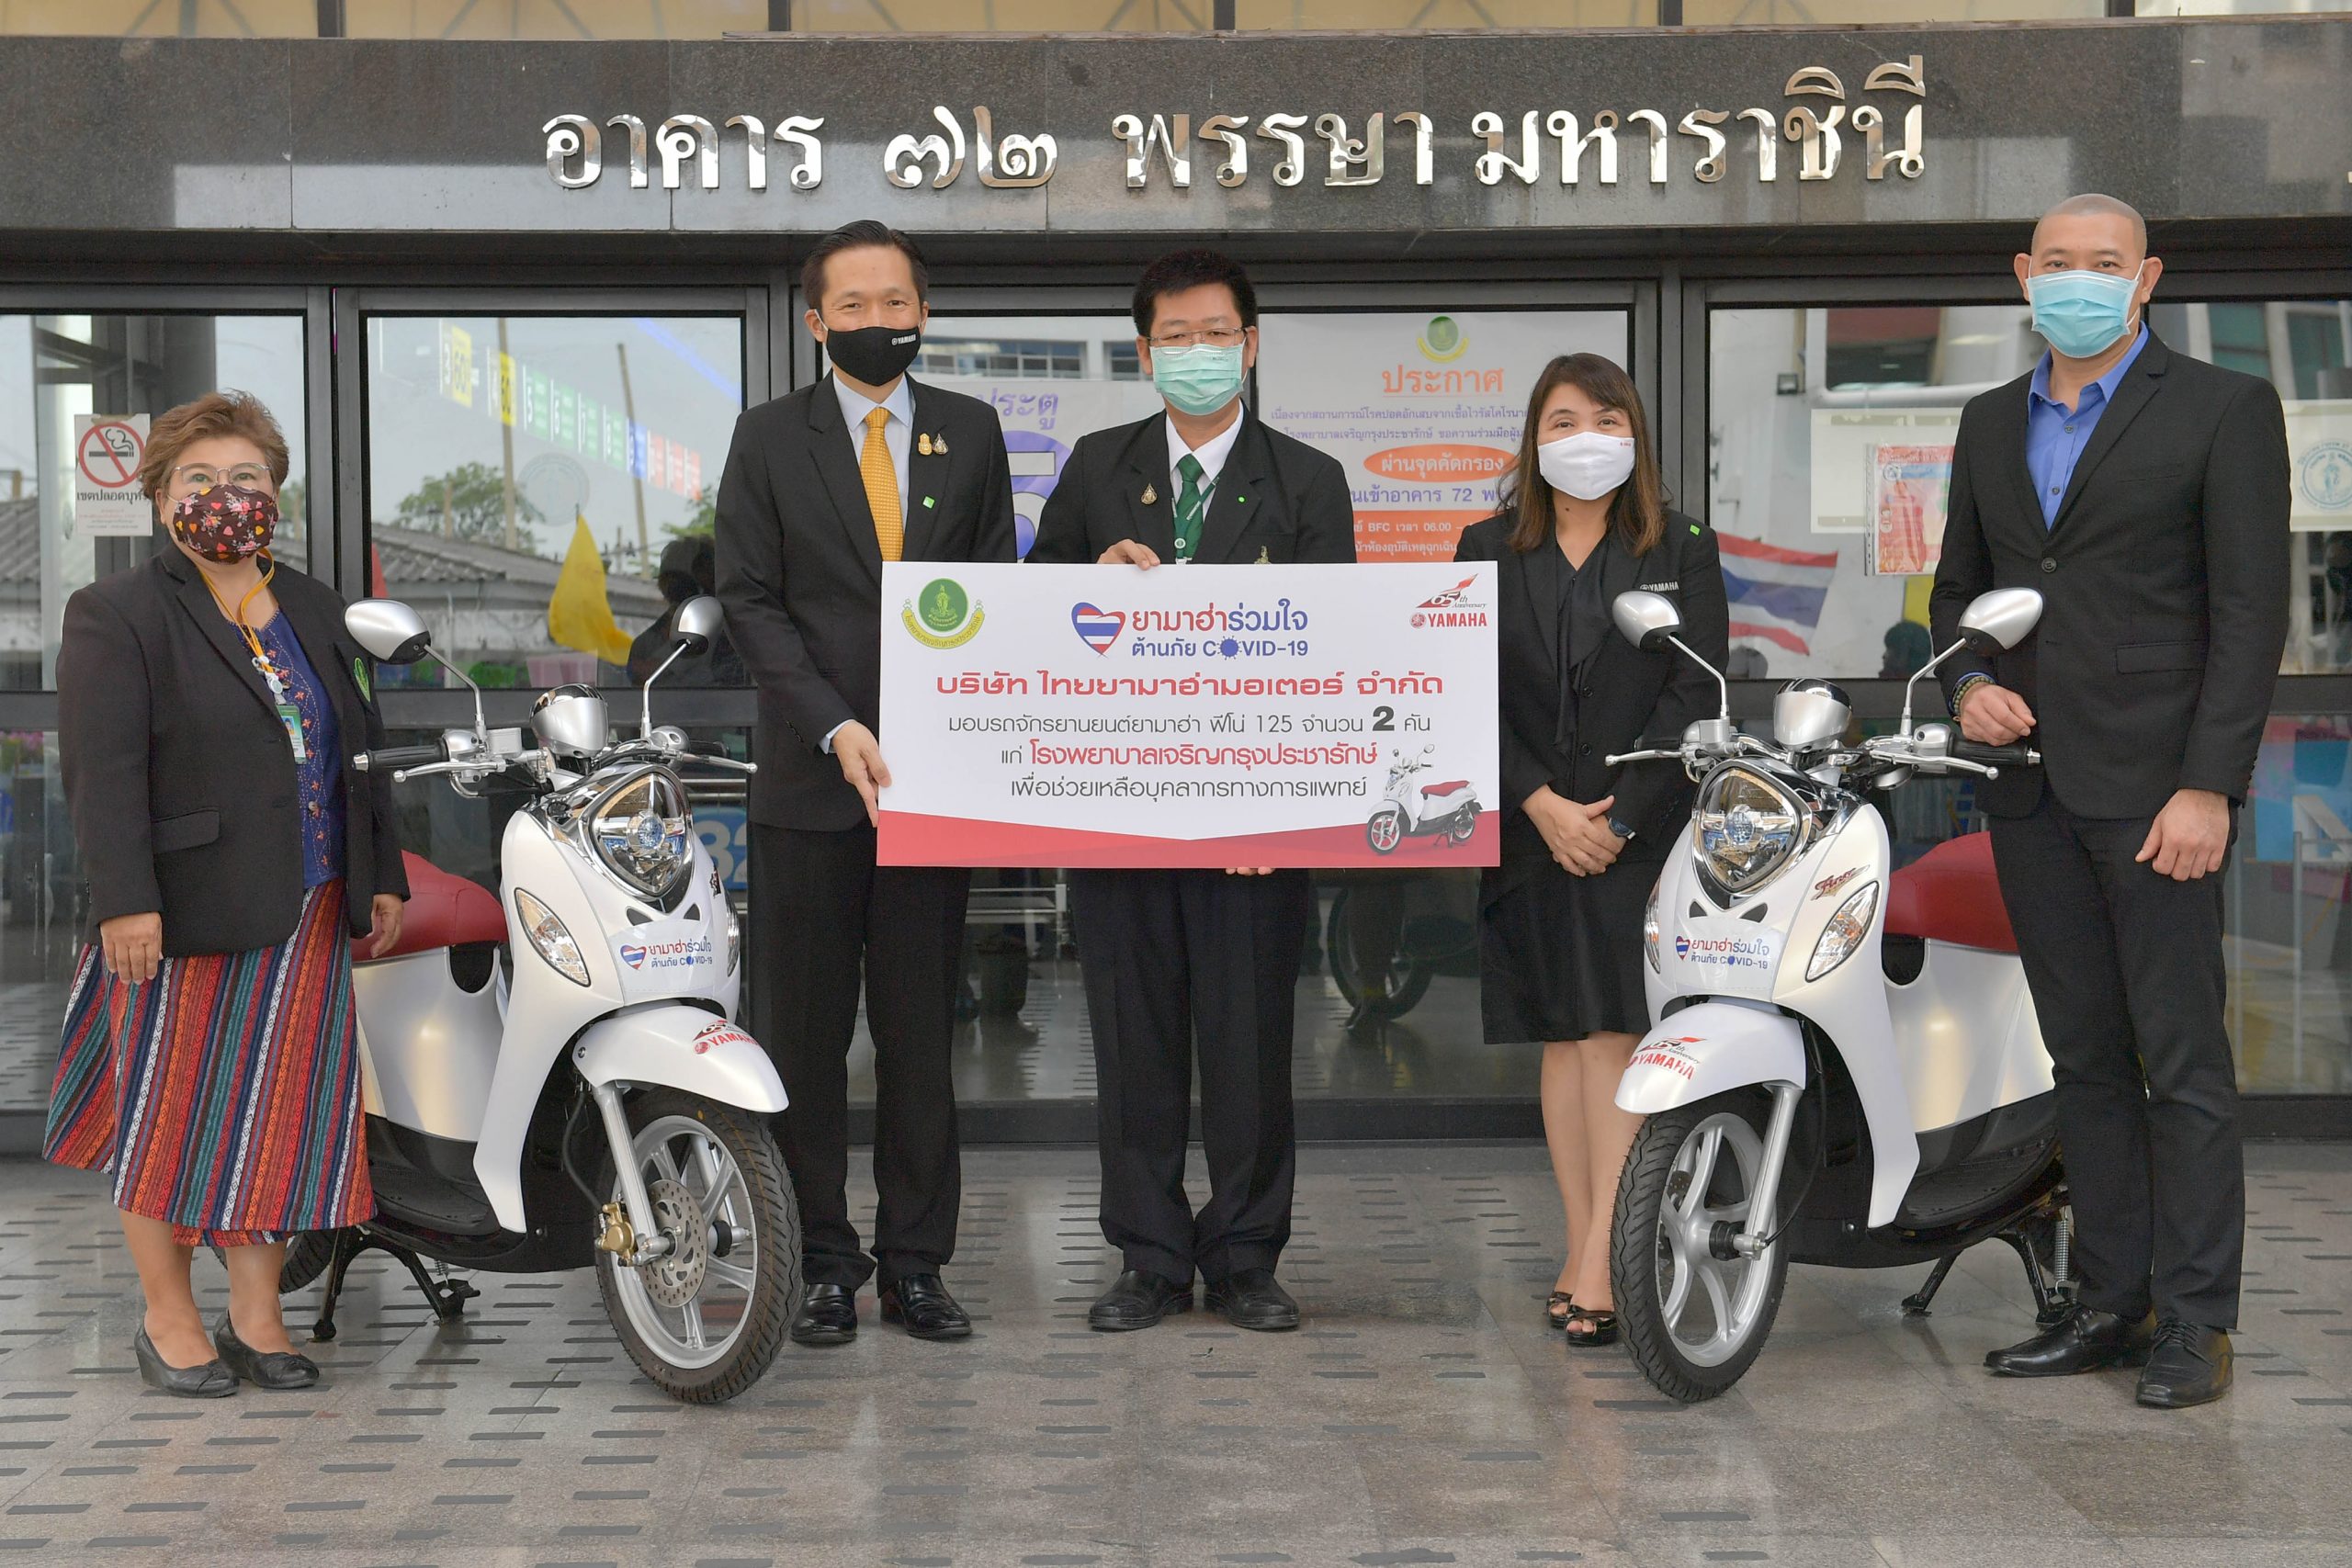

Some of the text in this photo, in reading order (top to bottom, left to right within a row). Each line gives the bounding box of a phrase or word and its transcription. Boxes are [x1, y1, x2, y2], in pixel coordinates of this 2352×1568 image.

[542, 54, 1926, 190] อาคาร ๗๒ พรรษา มหาราชินี
[1382, 365, 1504, 394] ประกาศ
[1452, 488, 1472, 502] 72
[1368, 522, 1390, 532] BFC
[1423, 522, 1451, 532] 06.00
[1649, 581, 1679, 592] YAMAHA
[1133, 598, 1308, 631] ยามาฮ่าร่วมใจ
[1428, 612, 1487, 627] YAMAHA
[1132, 637, 1196, 657] ต้านภัย
[936, 670, 1443, 695] บริษัท ไทยยามาฮ่ามอเตอร์ จำกัด
[949, 705, 1430, 733] มอบรถจักรยานยนต์ยามาฮ่า ฟีโน่ 125 จำนวน 2 คัน
[1001, 739, 1378, 770] แก่ โรงพยาบาลเจริญกรุงประชารักษ์
[1011, 772, 1367, 803] เพื่อช่วยเหลือบุคลากรทางการแพทย์
[649, 935, 712, 955] ยามาฮ่าร่วมใจ
[1691, 937, 1770, 956] ยามาฮ่าร่วมใจ
[650, 957, 678, 969] ต้านภัย
[1690, 952, 1718, 964] ต้านภัย
[1638, 1053, 1695, 1080] YAMAHA
